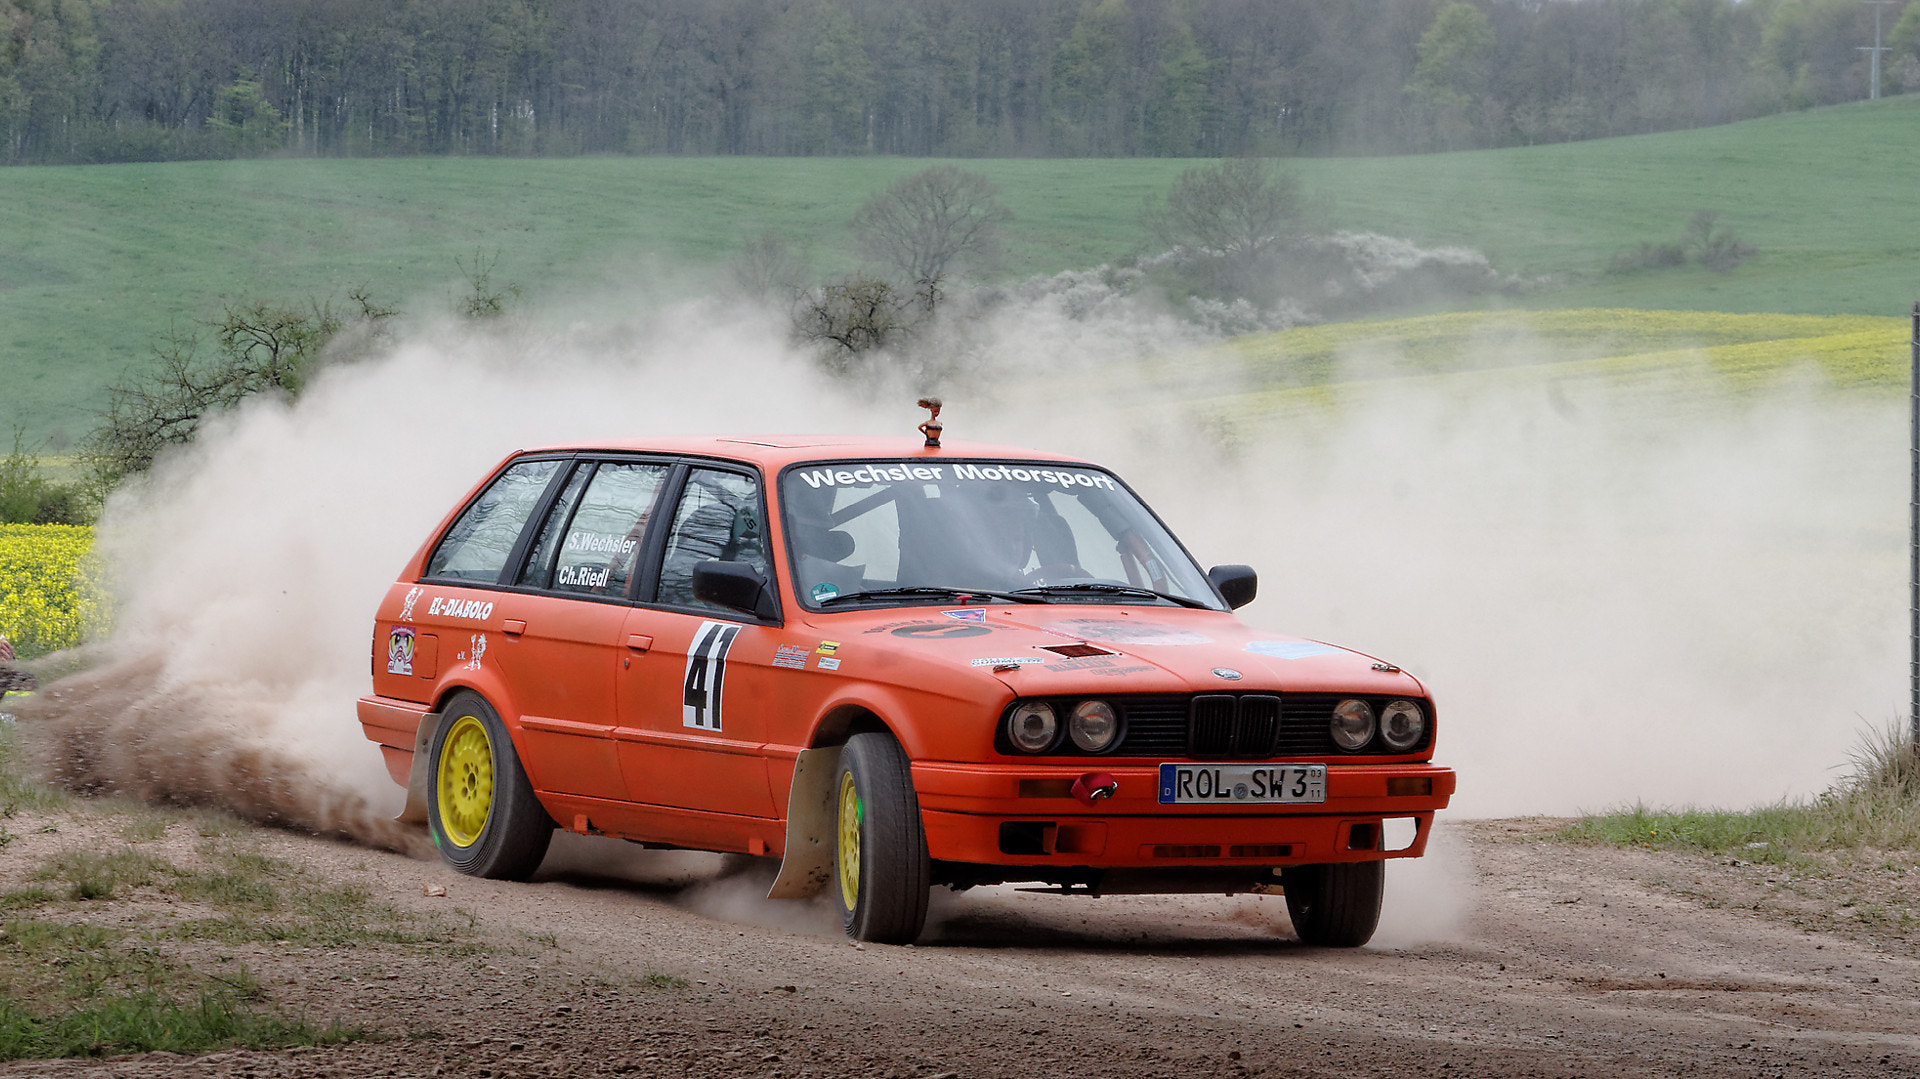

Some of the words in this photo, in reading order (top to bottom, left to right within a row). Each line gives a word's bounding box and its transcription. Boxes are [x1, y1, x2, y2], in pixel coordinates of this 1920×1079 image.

[799, 463, 944, 490] Wechsler
[951, 463, 1116, 491] Motorsport
[568, 532, 637, 554] S.Wechsler
[558, 565, 610, 588] Ch.Riedl
[427, 596, 494, 621] EL-DIABOLO
[683, 623, 740, 730] 41
[1176, 768, 1232, 799] ROL
[1250, 768, 1286, 799] SW
[1291, 768, 1308, 798] 3
[1310, 769, 1322, 778] 03
[1163, 787, 1171, 796] D
[1311, 789, 1321, 798] 11
